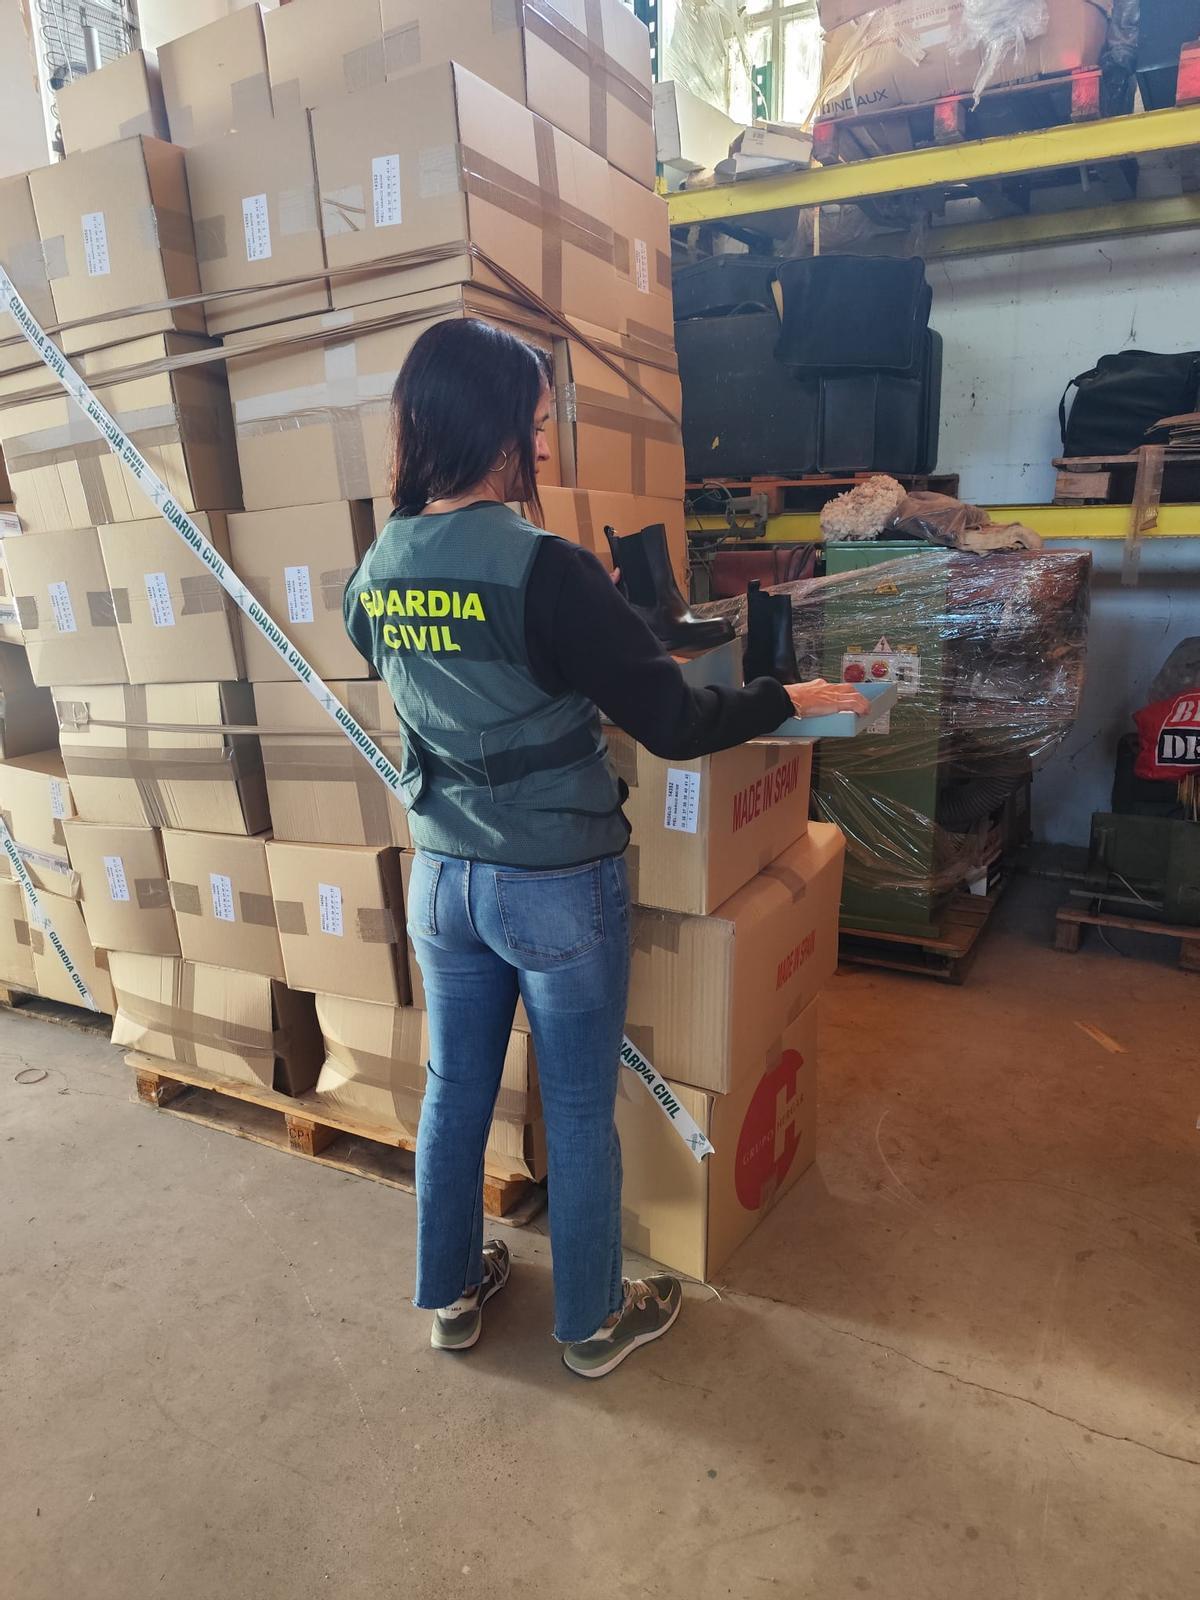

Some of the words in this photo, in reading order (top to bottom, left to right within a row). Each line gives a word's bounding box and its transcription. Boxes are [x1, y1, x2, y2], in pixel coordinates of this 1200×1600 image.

[162, 499, 202, 551] GUARDIA
[202, 547, 225, 580] CIVIL
[360, 589, 486, 621] GUARDIA
[383, 624, 461, 652] CIVIL
[249, 602, 288, 654] GUARDIA
[288, 650, 312, 683] CIVIL
[335, 707, 377, 760] GUARDIA
[375, 756, 401, 789] CIVIL
[732, 779, 762, 833] MADE
[762, 772, 774, 813] IN
[774, 755, 800, 804] SPAIN
[4, 839, 27, 881] GUARDIA
[24, 882, 39, 905] CIVIL
[50, 931, 75, 973] GUARDIA
[72, 972, 88, 998] CIVIL
[776, 949, 794, 991] MADE
[800, 928, 816, 966] SPAIN
[653, 1083, 680, 1119] CIVIL
